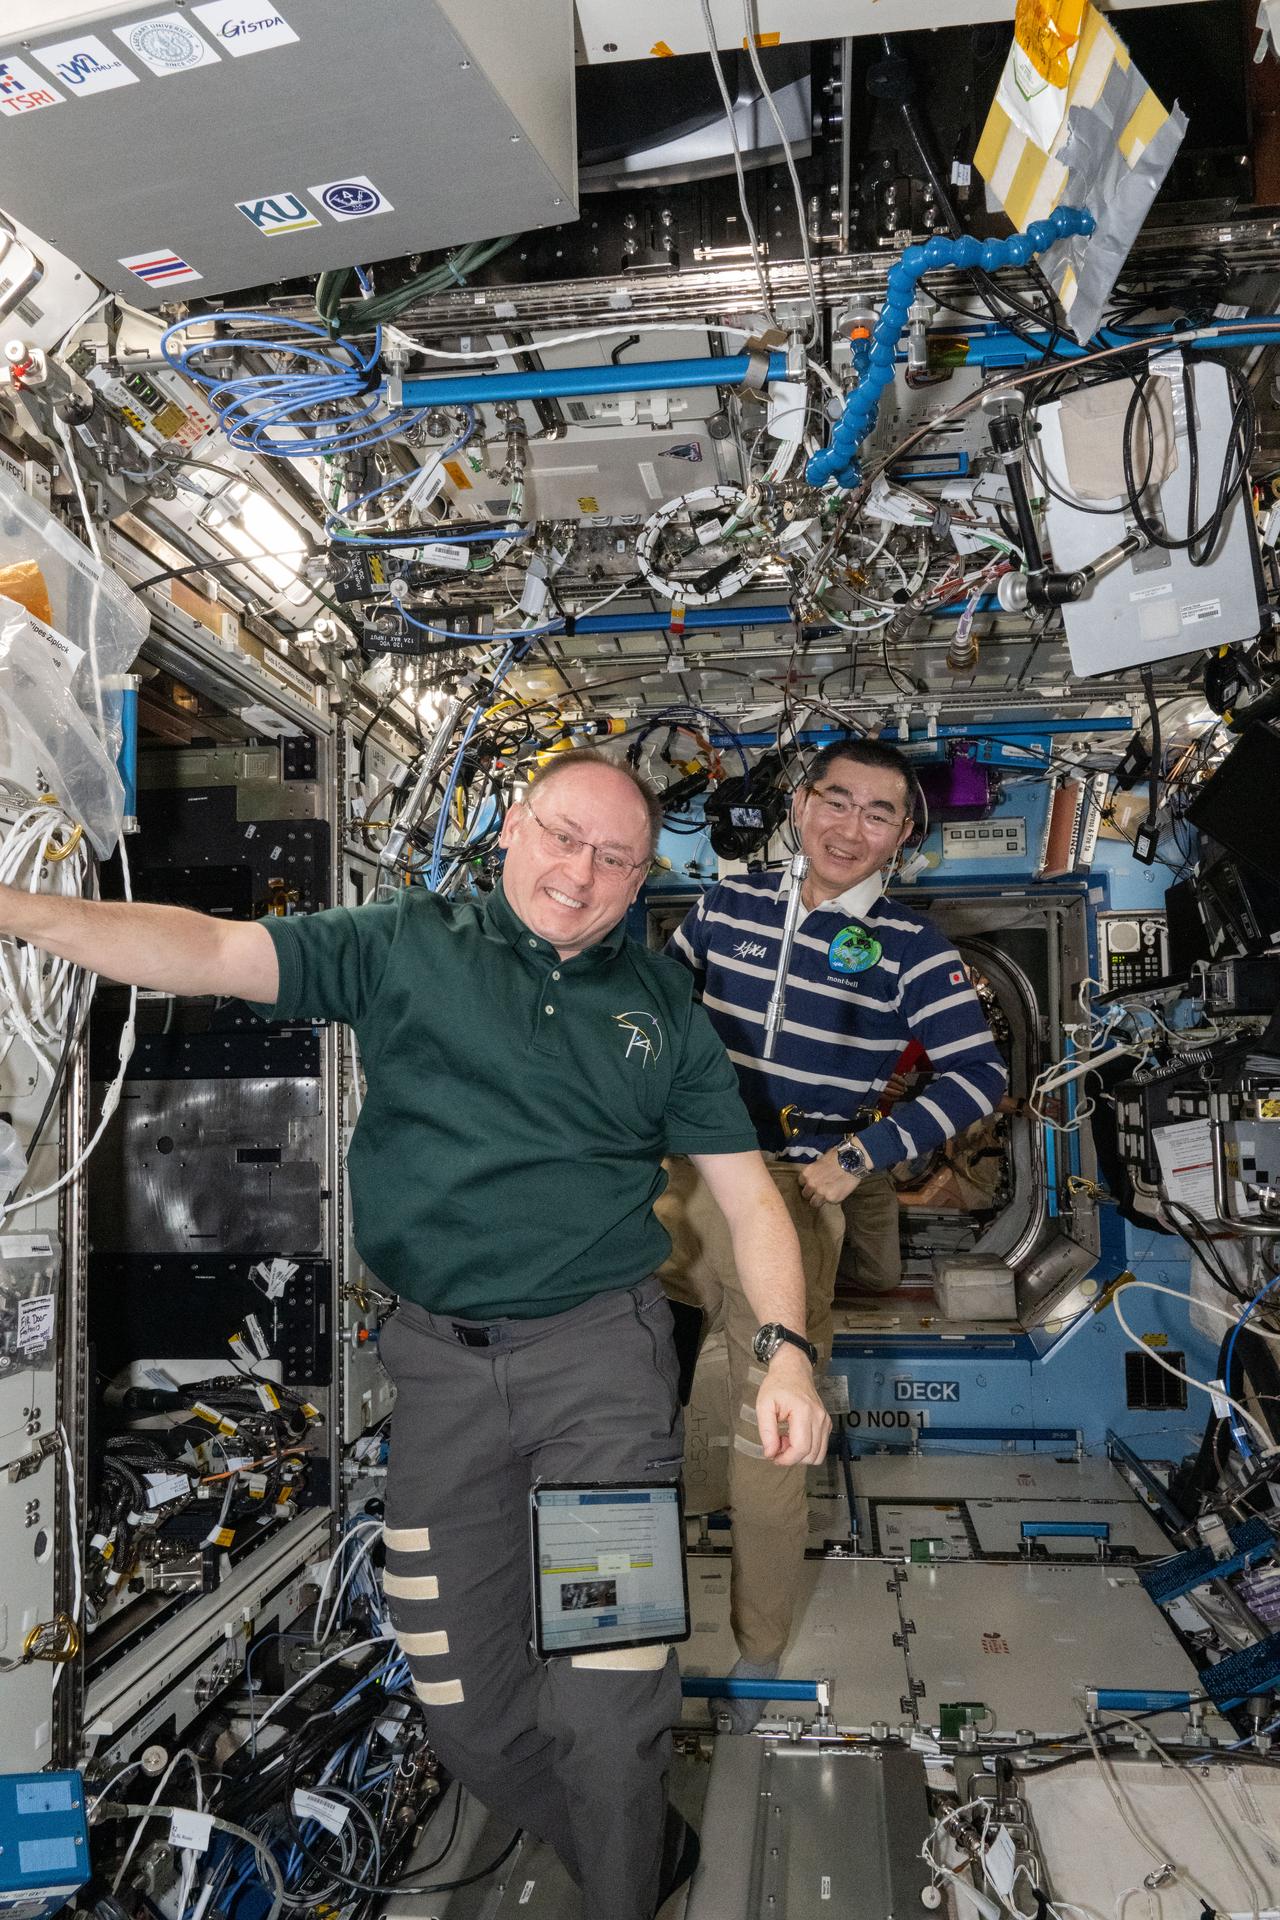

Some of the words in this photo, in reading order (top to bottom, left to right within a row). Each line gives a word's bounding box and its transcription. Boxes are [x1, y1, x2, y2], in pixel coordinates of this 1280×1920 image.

[150, 23, 194, 39] UNIVERSITY
[92, 61, 122, 73] PMU-B
[2, 89, 56, 111] TSRI
[238, 194, 308, 228] KU
[46, 633, 70, 654] Ziplock
[1069, 802, 1083, 855] WARNING
[1085, 833, 1094, 845] Fire
[732, 940, 767, 959] JAXA
[897, 1382, 958, 1401] DECK
[867, 1410, 910, 1428] NOD
[916, 1410, 925, 1428] 1
